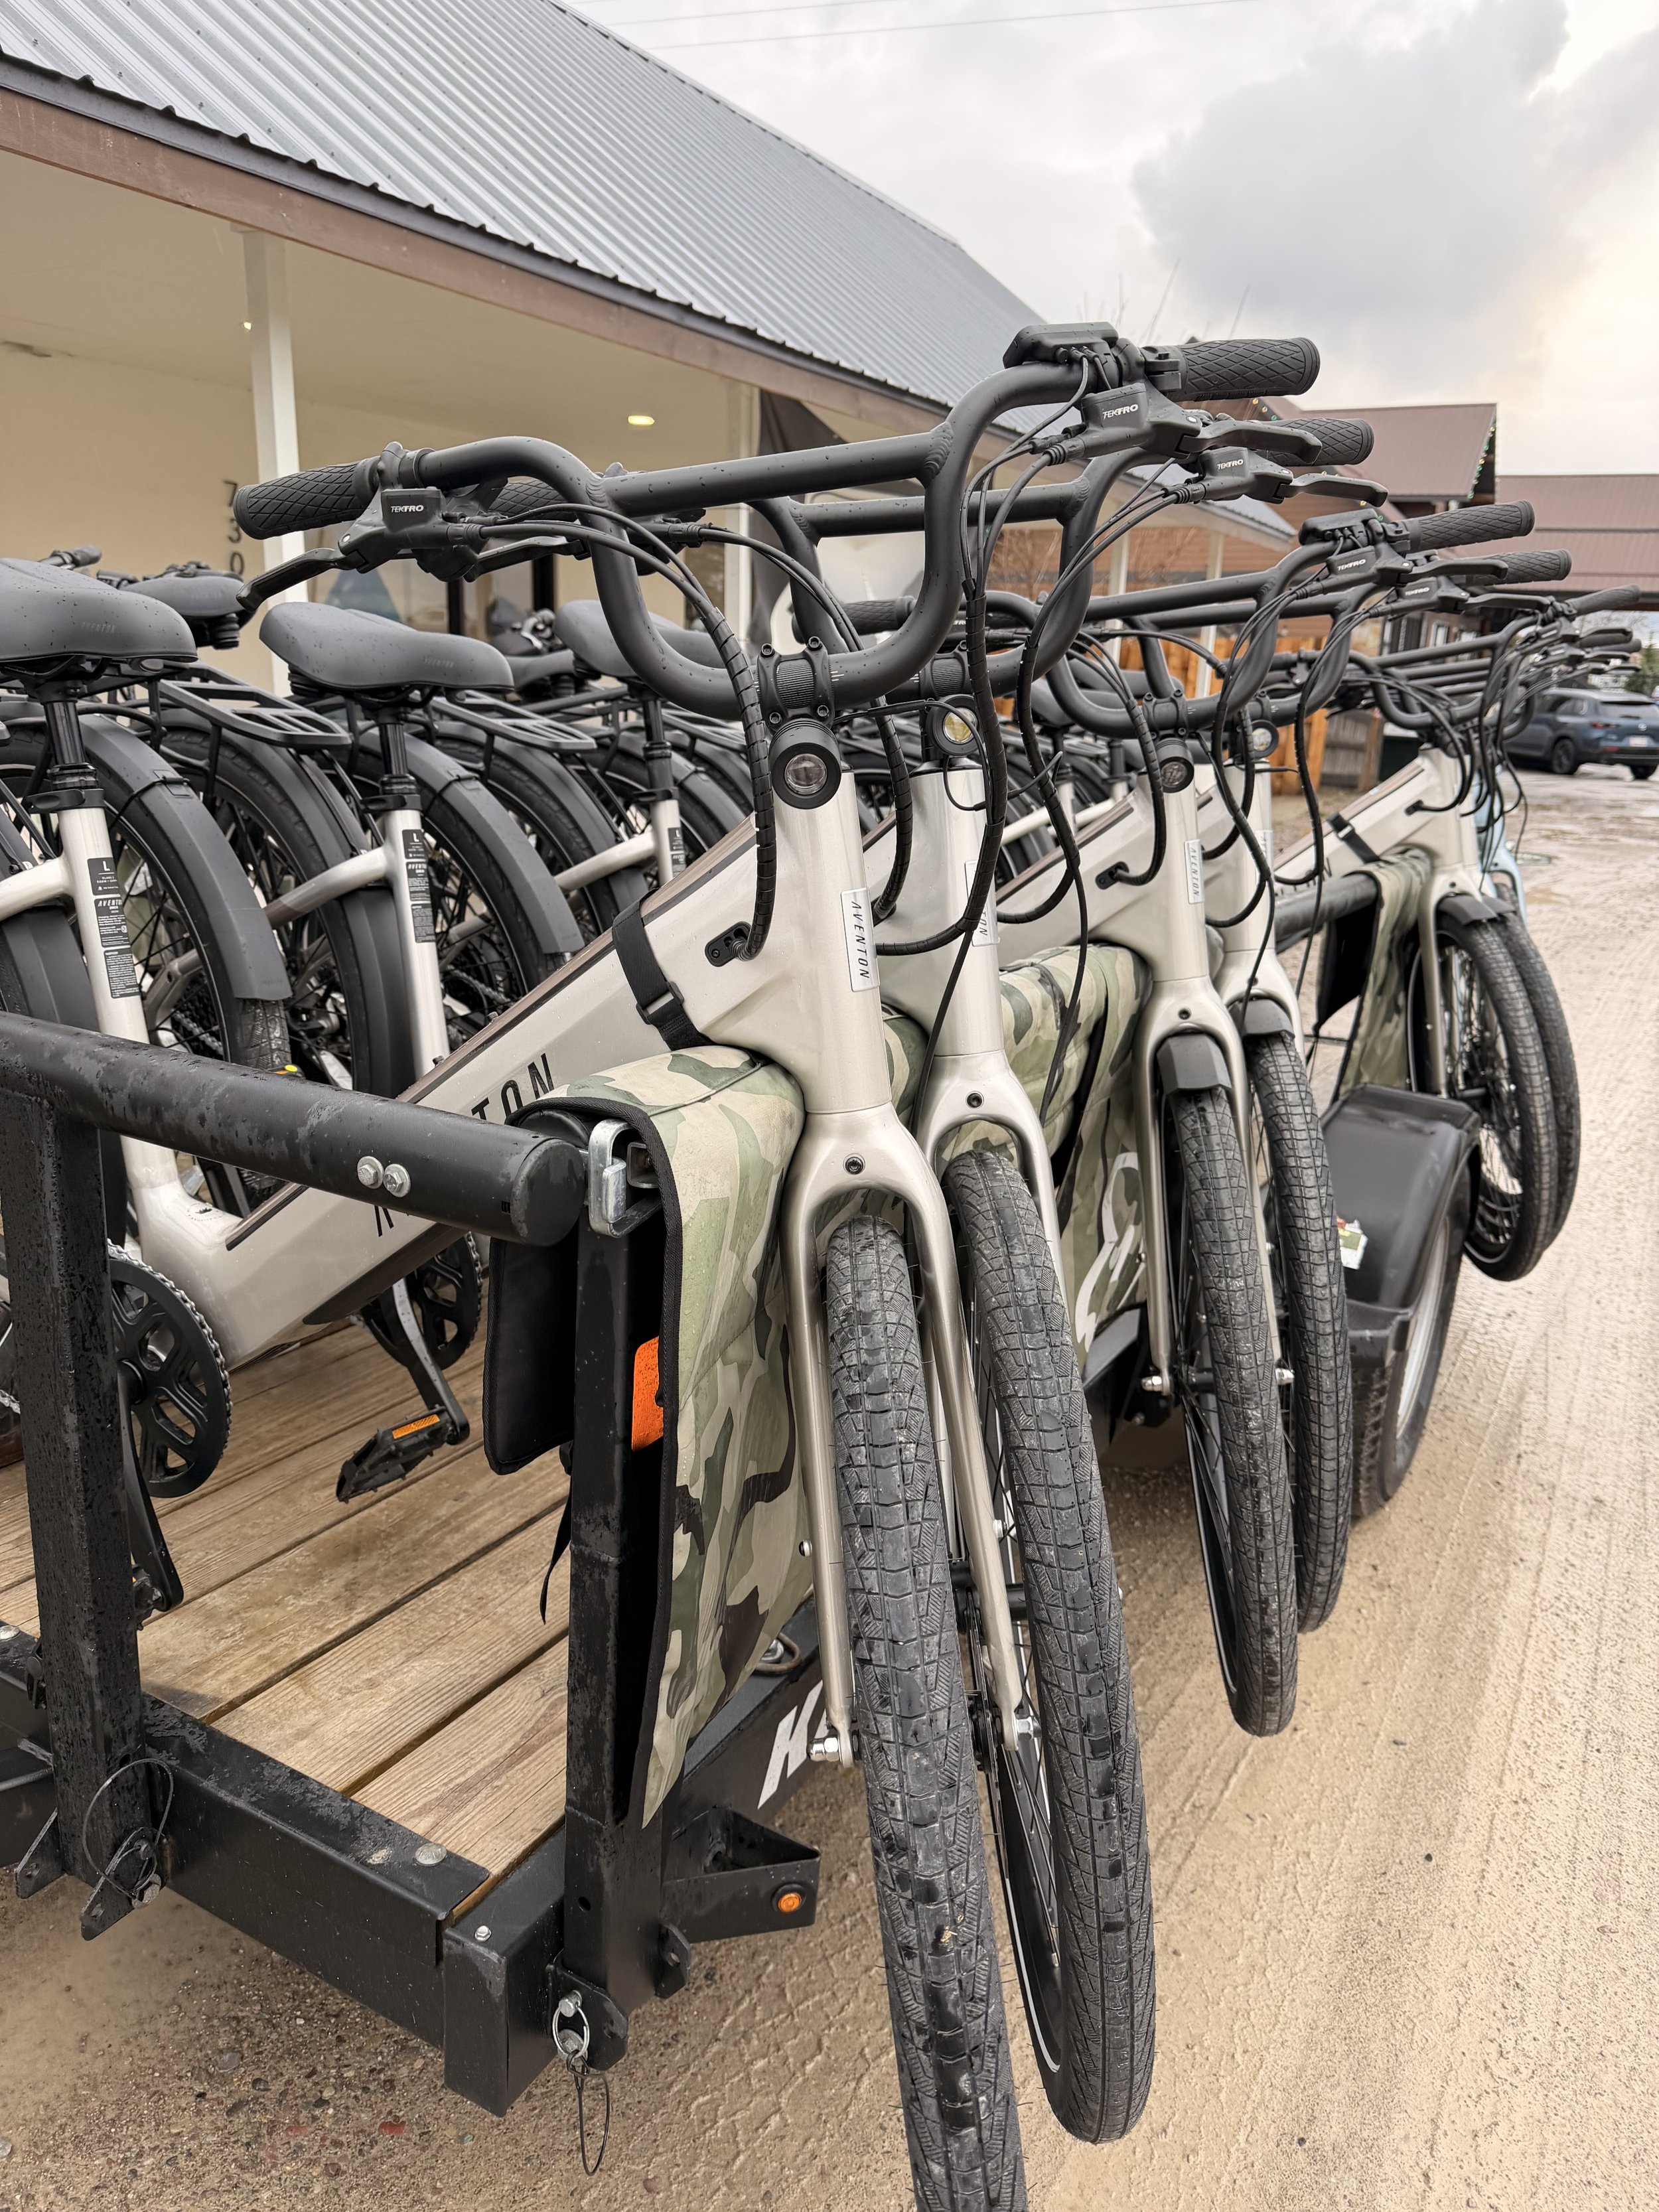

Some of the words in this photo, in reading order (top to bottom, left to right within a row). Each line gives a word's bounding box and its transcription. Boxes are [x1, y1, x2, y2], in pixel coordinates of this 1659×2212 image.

[1102, 404, 1139, 419] TEKTRO
[1217, 459, 1244, 470] TEKTRO
[1337, 559, 1366, 571] TEKTRO
[413, 832, 420, 842] L
[102, 861, 111, 871] L
[1190, 848, 1200, 897] AVENTON
[851, 901, 870, 979] AVENTON
